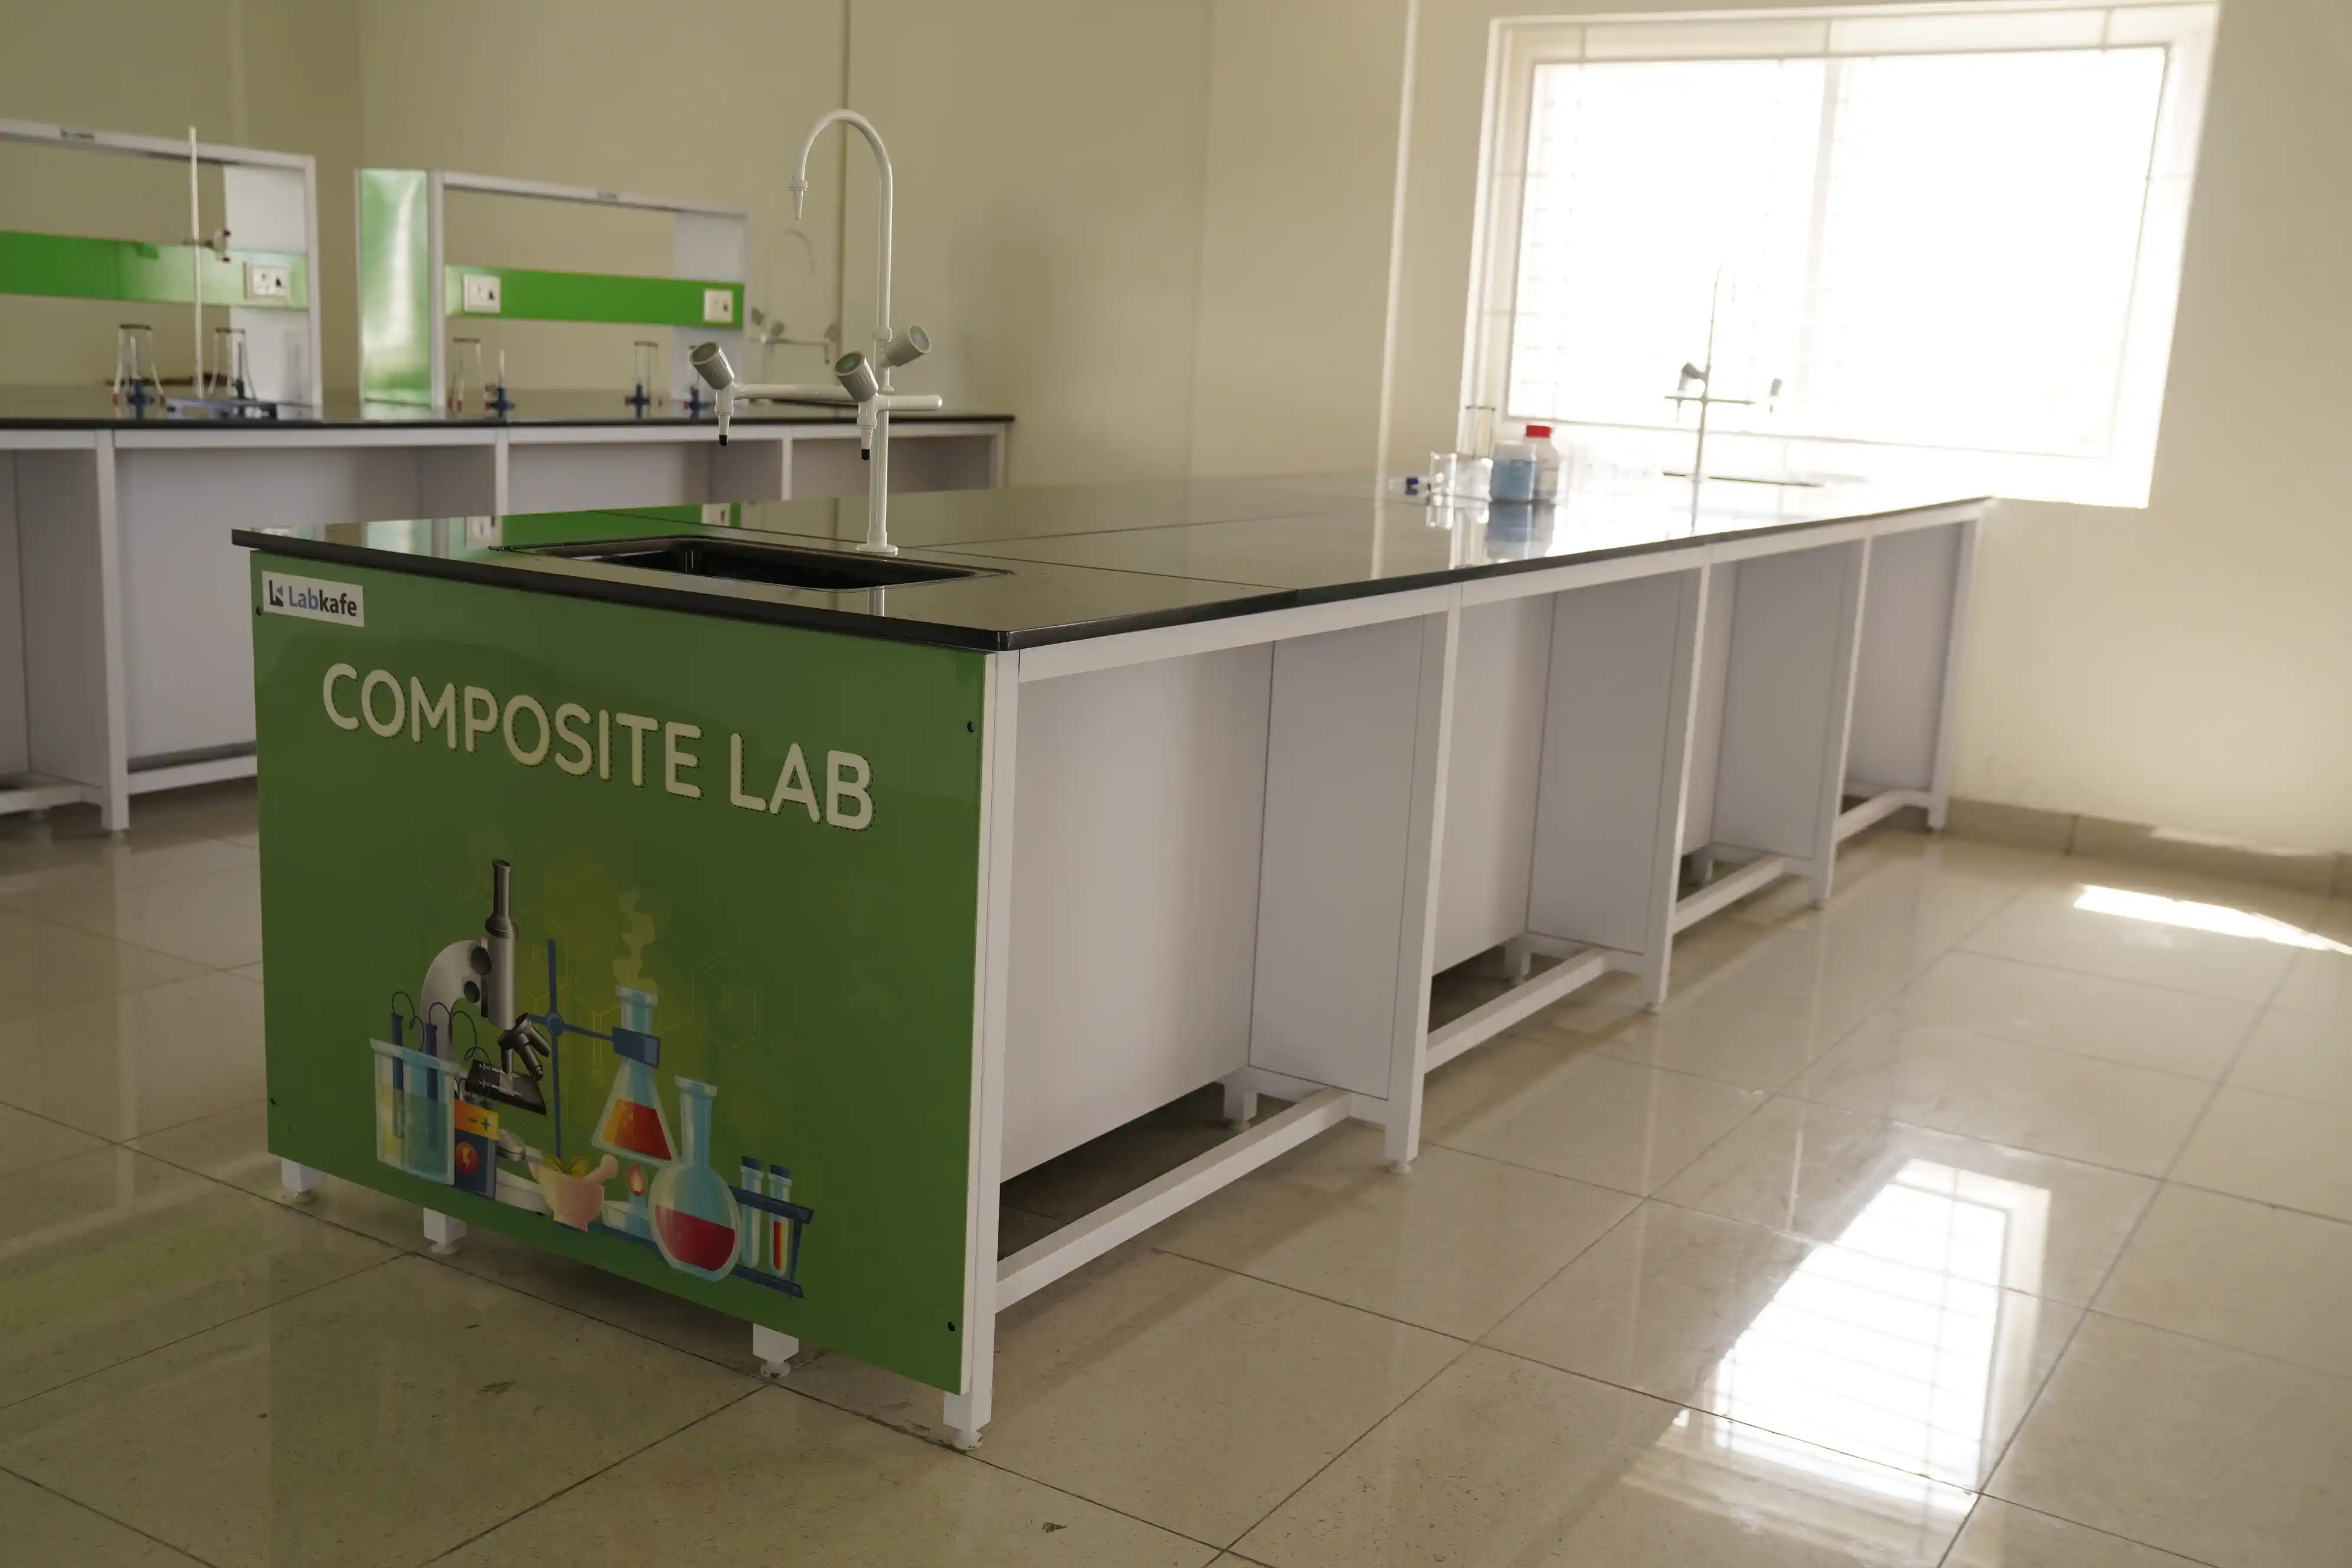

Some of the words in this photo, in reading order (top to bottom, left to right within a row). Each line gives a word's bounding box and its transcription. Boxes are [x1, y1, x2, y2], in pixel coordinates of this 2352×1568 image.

[289, 586, 357, 616] Labkafe
[323, 663, 703, 798] COMPOSITE
[730, 733, 874, 829] LAB
